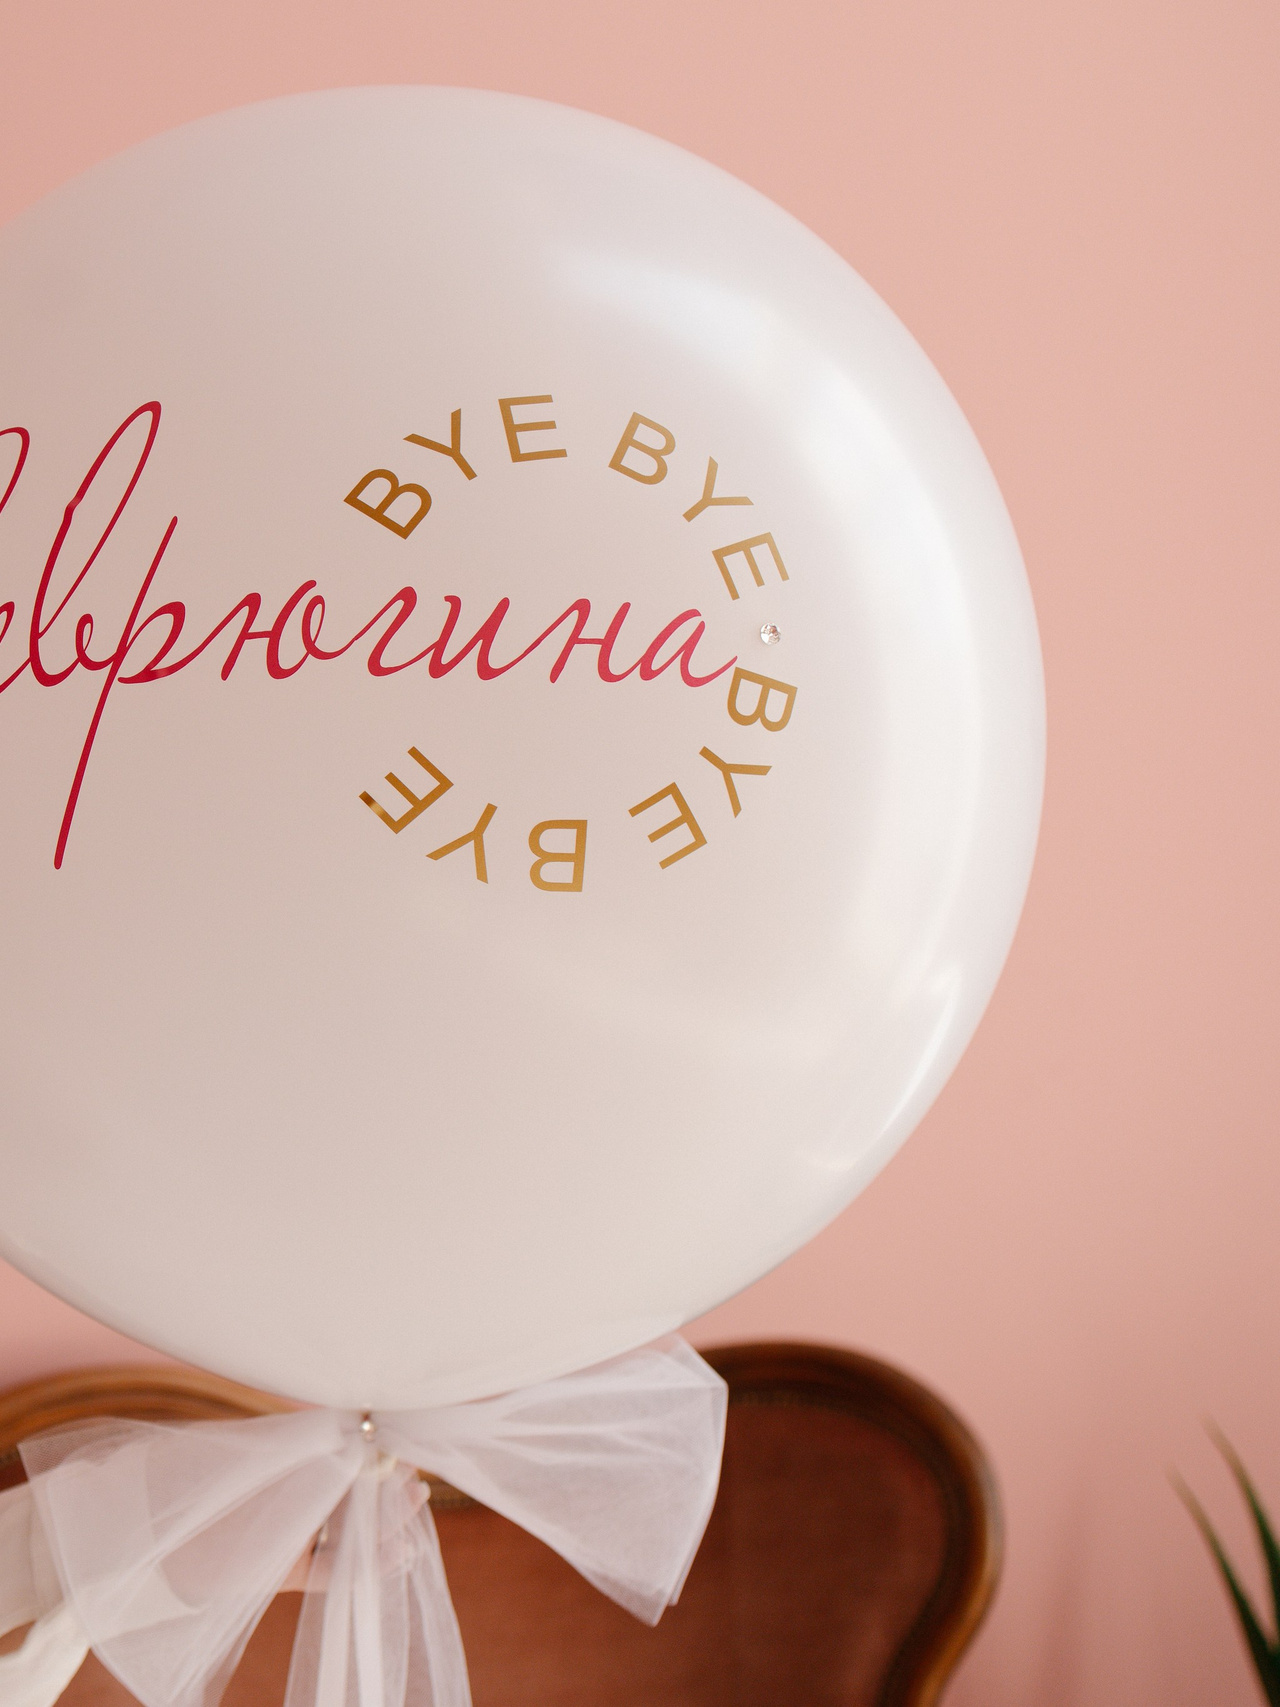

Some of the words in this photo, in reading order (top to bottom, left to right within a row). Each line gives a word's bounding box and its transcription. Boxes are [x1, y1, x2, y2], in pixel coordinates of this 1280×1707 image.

[342, 394, 568, 540] BYE
[608, 412, 789, 601] BYE
[357, 745, 588, 893] BYE
[627, 666, 798, 870] BYE
